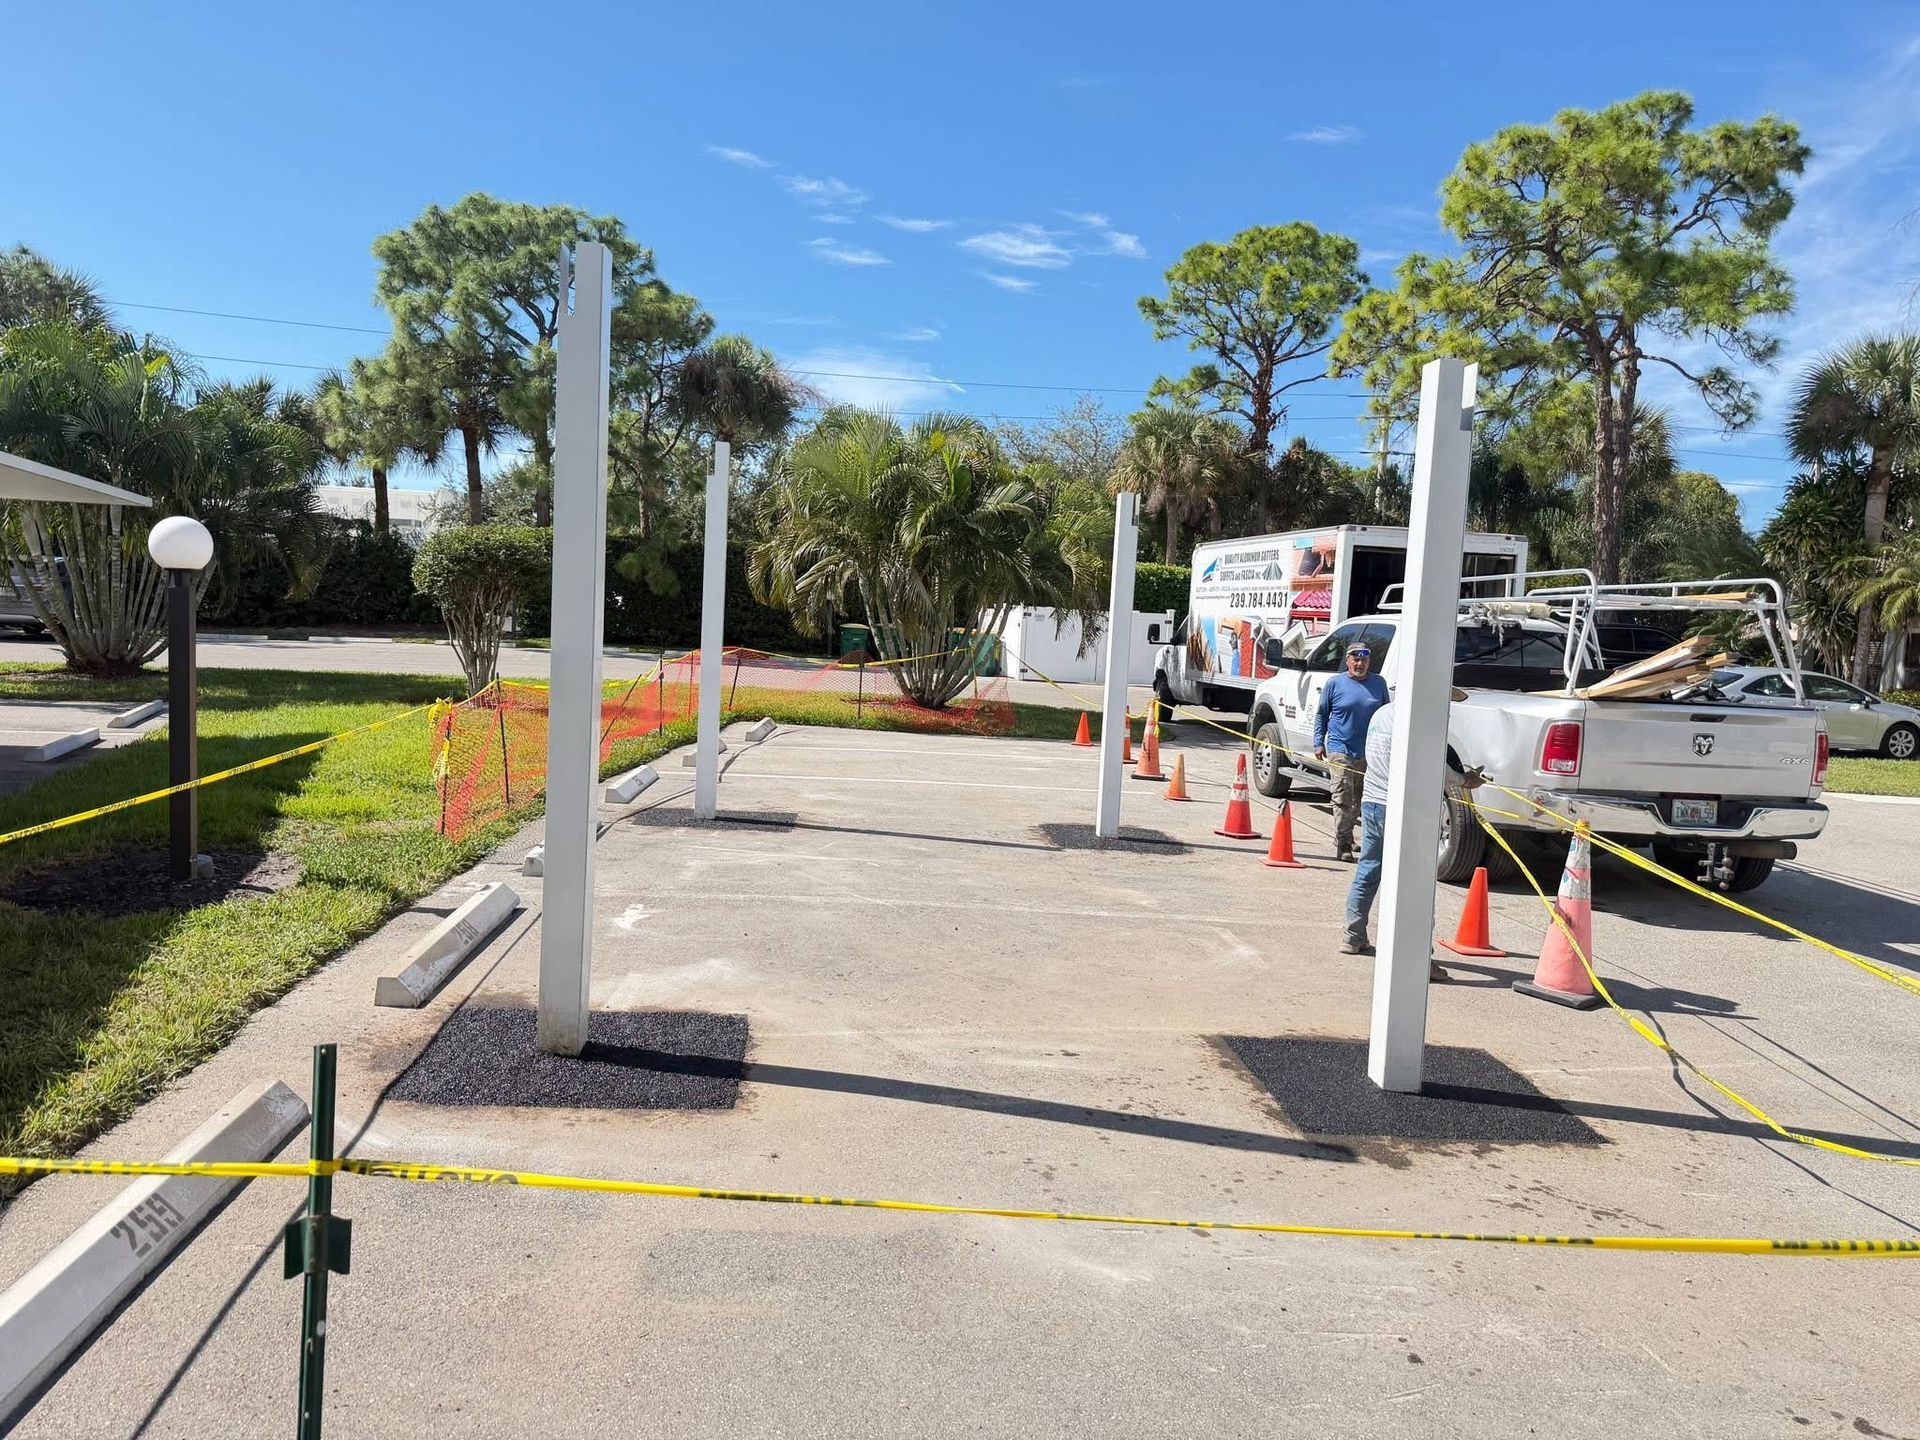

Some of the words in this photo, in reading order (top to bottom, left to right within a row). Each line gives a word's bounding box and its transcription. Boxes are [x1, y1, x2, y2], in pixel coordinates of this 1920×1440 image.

[1225, 554, 1240, 566] QUALITY
[1240, 552, 1260, 563] ALUMINUM
[1261, 549, 1279, 561] GUTTERS
[1241, 569, 1255, 581] FASCIA
[1230, 592, 1288, 608] 239.784.4431
[110, 1192, 186, 1258] 259
